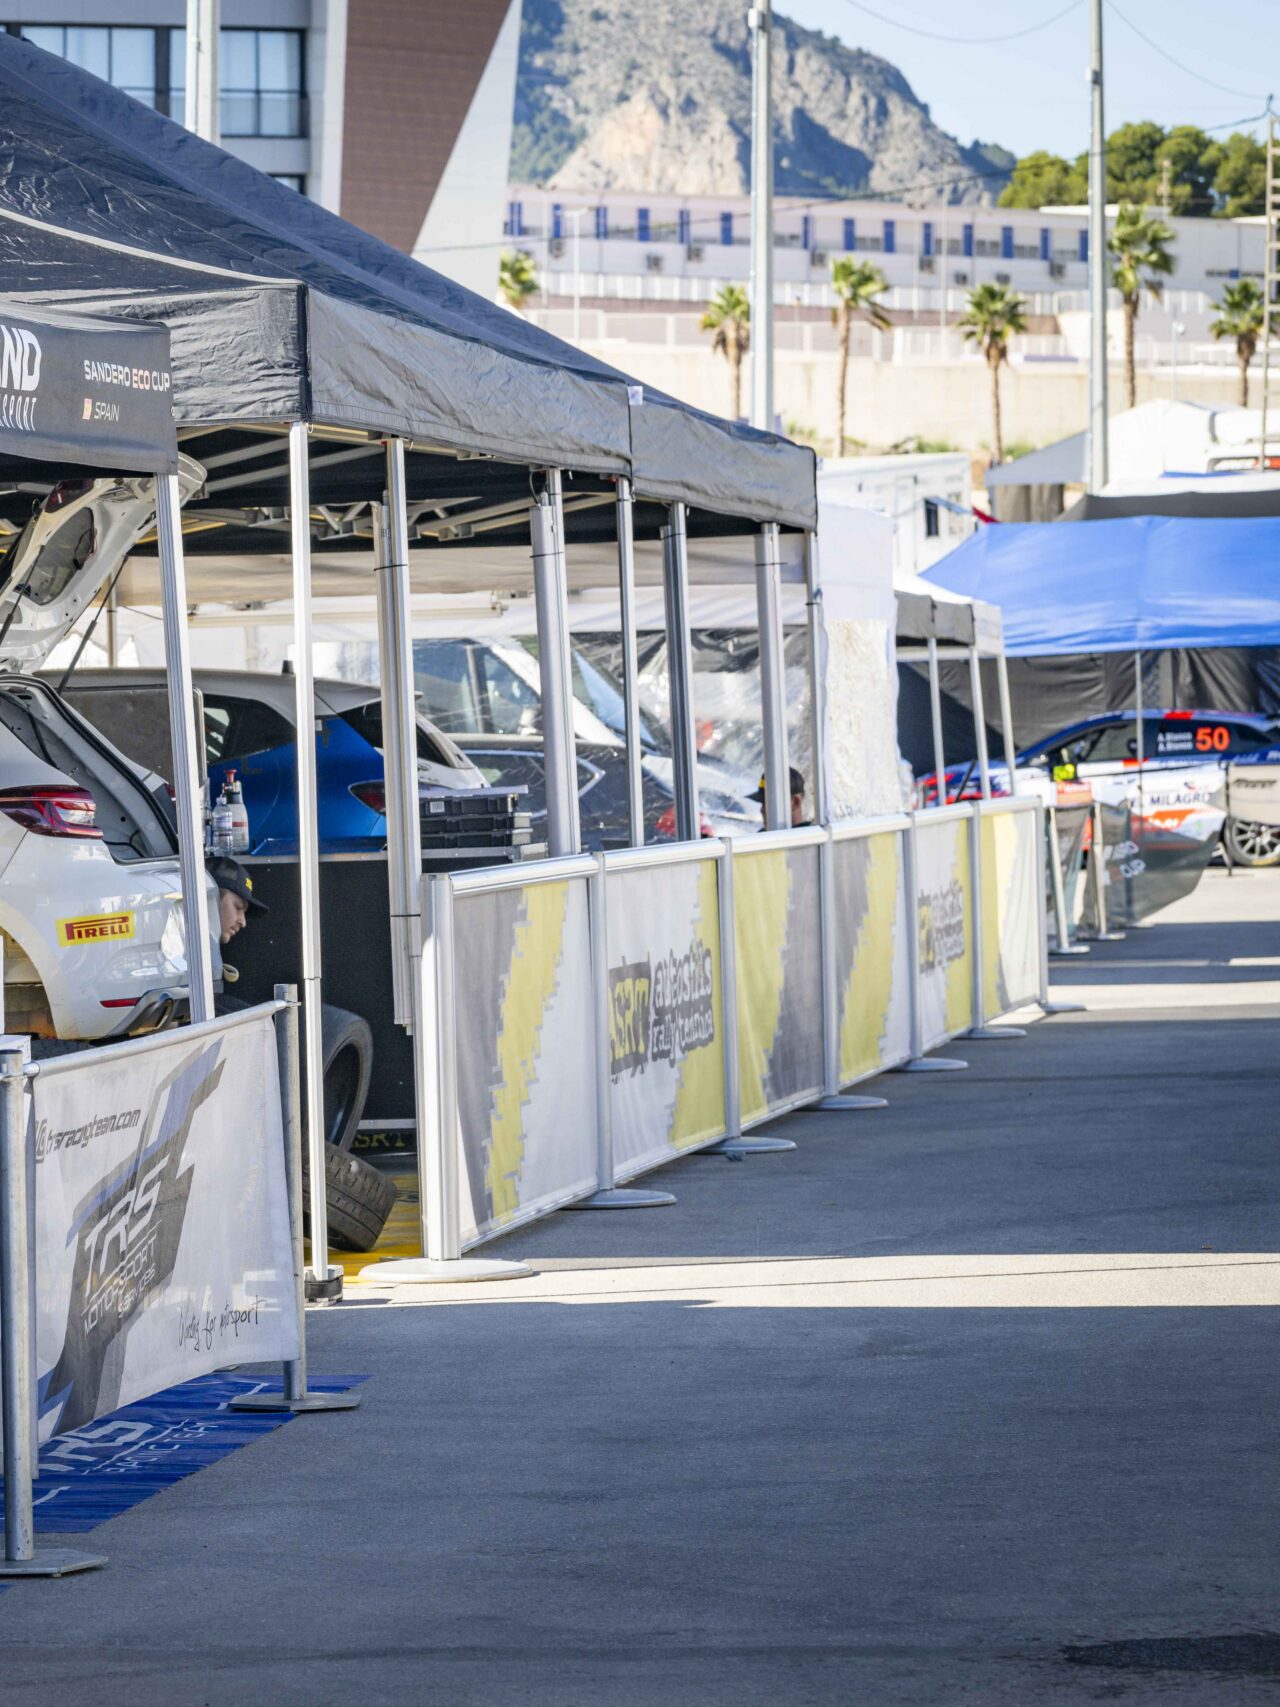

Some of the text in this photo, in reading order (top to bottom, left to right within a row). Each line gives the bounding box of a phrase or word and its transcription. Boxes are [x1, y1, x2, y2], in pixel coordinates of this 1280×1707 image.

[83, 359, 170, 392] SANDERO ECO CUP
[93, 401, 120, 422] SPAIN
[1195, 726, 1230, 752] 50
[65, 916, 130, 941] PIRELLI
